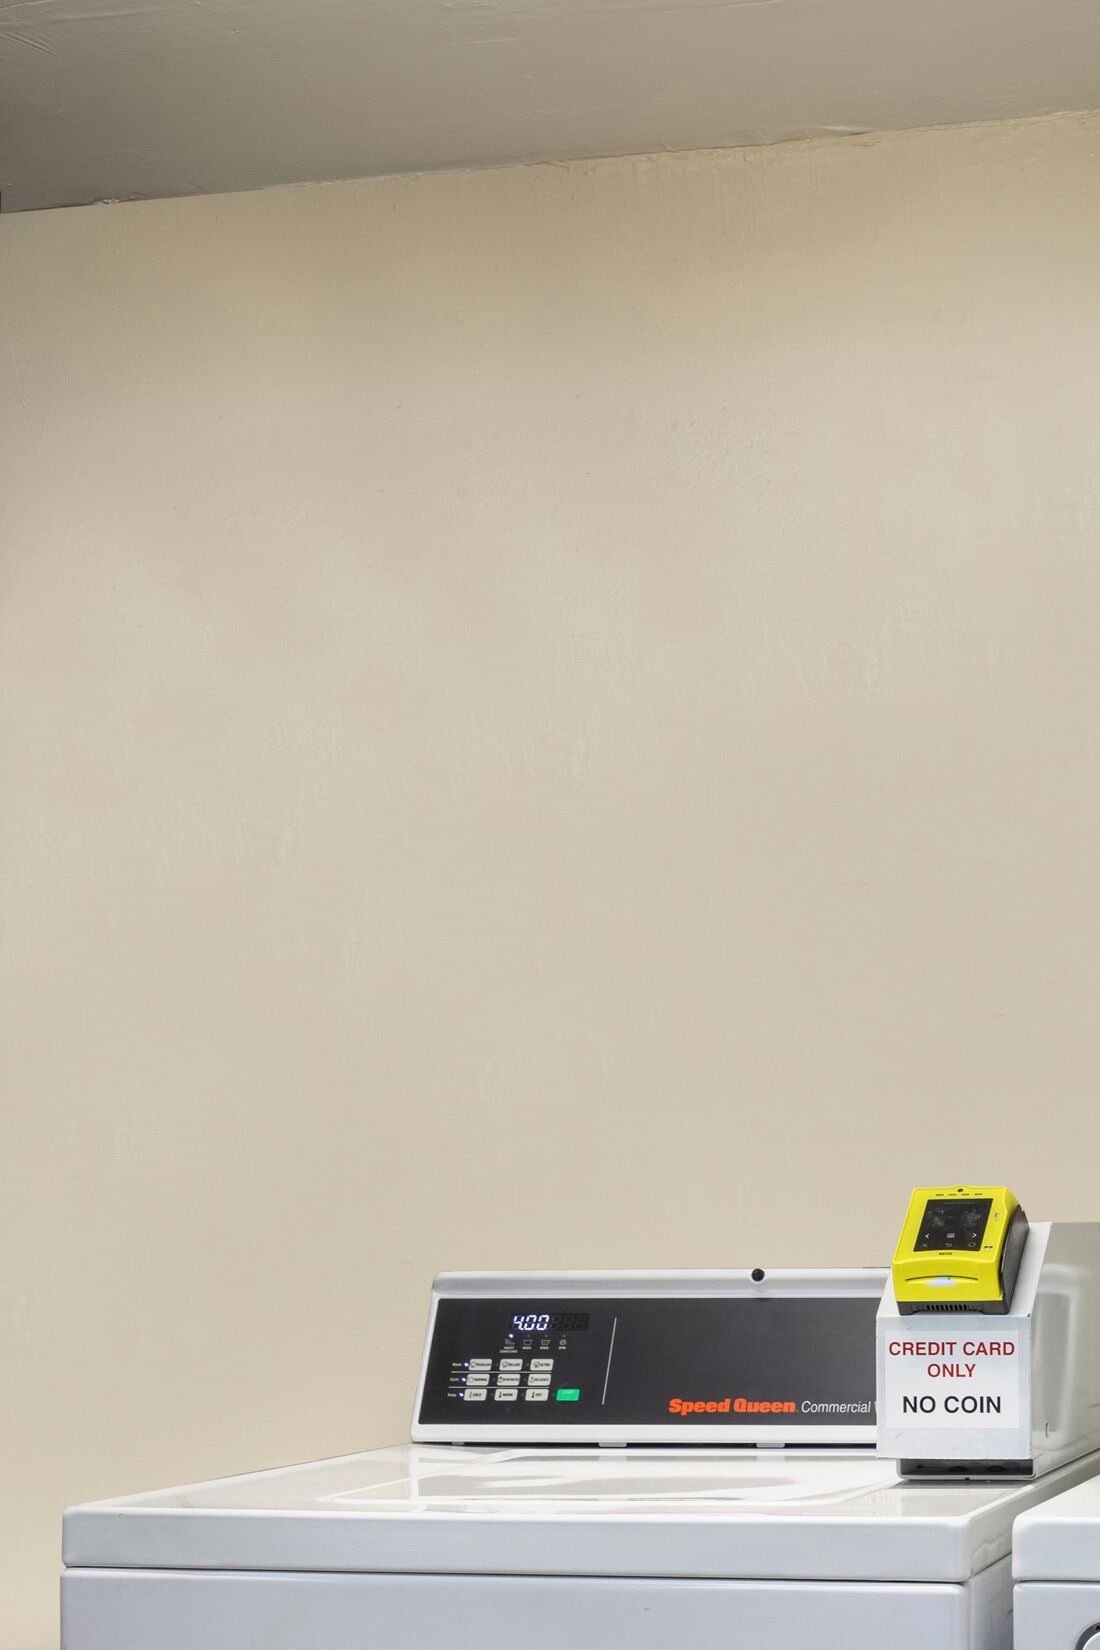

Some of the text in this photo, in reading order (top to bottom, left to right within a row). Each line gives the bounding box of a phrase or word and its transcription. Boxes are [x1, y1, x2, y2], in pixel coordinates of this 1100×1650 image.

[888, 1341, 1016, 1357] CREDIT CARD
[927, 1363, 976, 1378] ONLY
[668, 1398, 871, 1416] Speed Queen Commercial
[902, 1395, 1001, 1414] NO COIN
